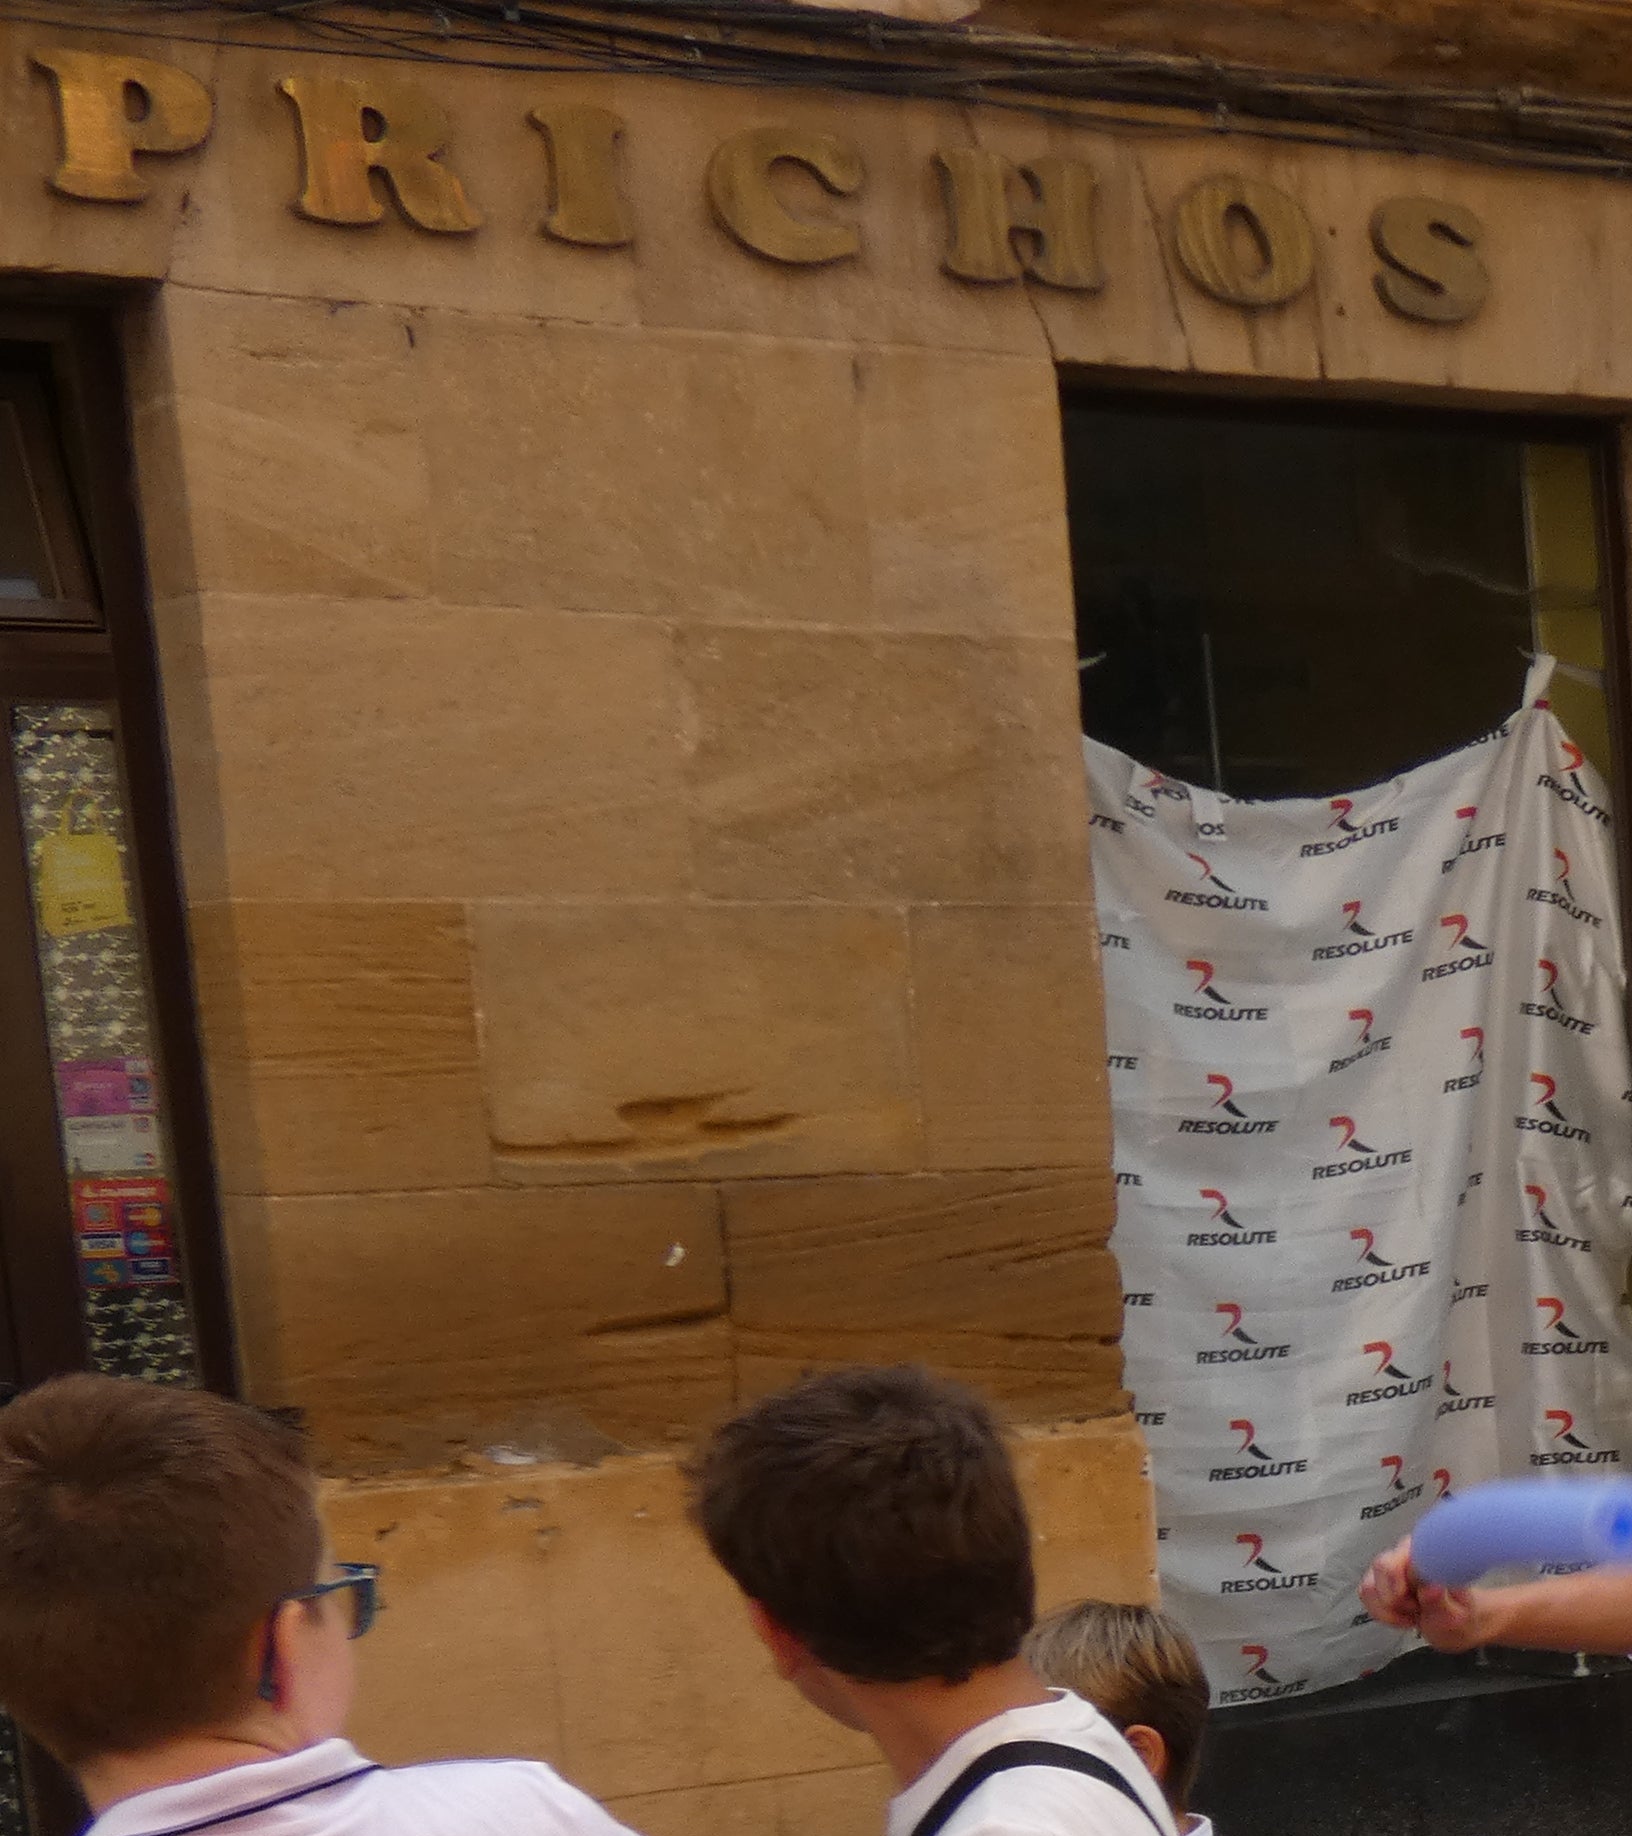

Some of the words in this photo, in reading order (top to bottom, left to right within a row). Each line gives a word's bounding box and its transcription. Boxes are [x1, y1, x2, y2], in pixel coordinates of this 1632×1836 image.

[1300, 817, 1400, 858] RESOLUTE
[1165, 889, 1269, 911] RESOLUTE
[1312, 929, 1414, 961] RESOLUTE
[1421, 953, 1495, 982] RESOLU
[1174, 1003, 1269, 1021] RESOLUTE
[1178, 1120, 1280, 1135] RESOLUTE
[1312, 1149, 1414, 1180] RESOLUTE
[1187, 1231, 1278, 1246] RESOLUTE
[1332, 1261, 1432, 1293] RESOLUTE
[1197, 1345, 1291, 1364] RESOLUTE
[1209, 1460, 1308, 1482] RESOLUTE
[1221, 1573, 1319, 1593] RESOLUTE
